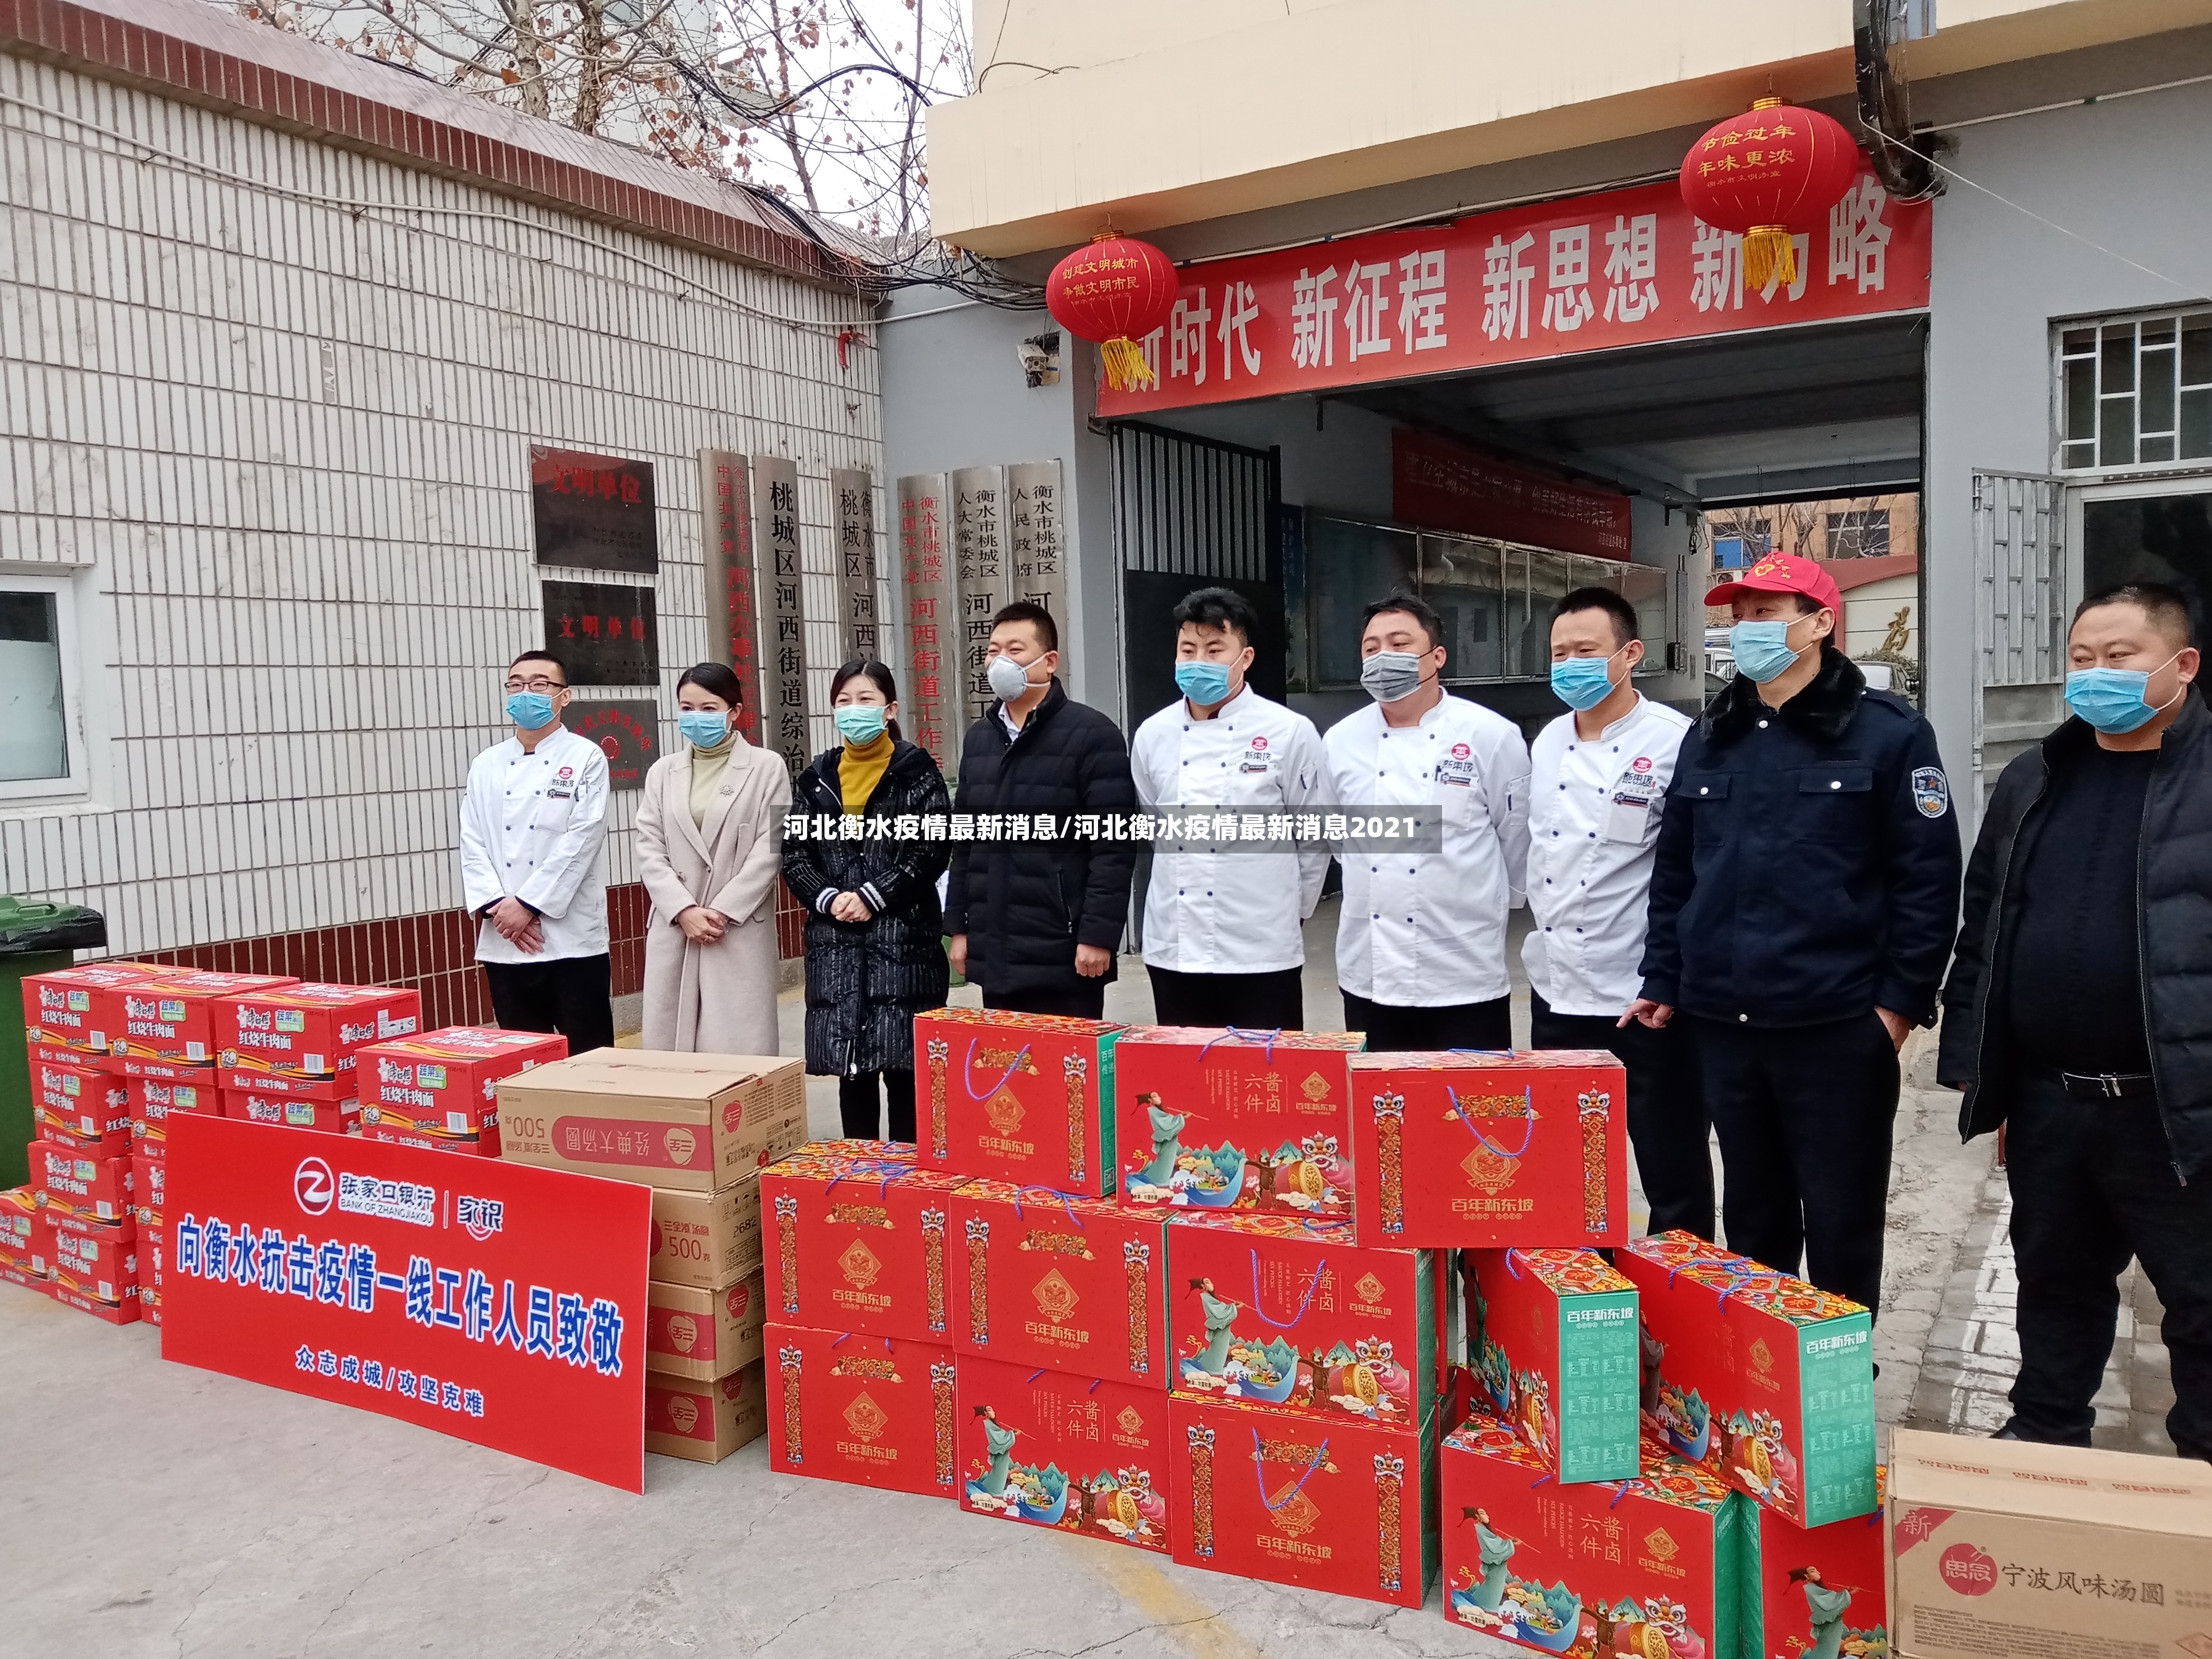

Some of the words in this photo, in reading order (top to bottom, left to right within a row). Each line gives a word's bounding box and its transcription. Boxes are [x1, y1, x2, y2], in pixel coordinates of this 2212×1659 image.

[1702, 124, 1796, 152] 节俭过年
[1698, 148, 1795, 178] 年味更浓
[1062, 257, 1138, 280] 创建文明城市
[1063, 276, 1139, 299] 争做文明市民
[1291, 248, 1448, 368] 新征程
[1481, 213, 1660, 342] 新思想
[548, 464, 642, 503] 文明单位
[717, 464, 734, 554] 中国共产党
[840, 488, 861, 579] 桃城区
[860, 490, 875, 580] 衡水市
[902, 499, 920, 584] 中国共产党
[919, 497, 943, 583] 衡水市桃城区
[958, 491, 977, 580] 人大常委会
[975, 489, 1000, 578] 衡水市桃城区
[1012, 488, 1033, 579] 人民政府
[1032, 484, 1057, 575] 衡水市桃城区
[558, 614, 646, 640] 文明单位
[852, 591, 876, 660] 河西
[41, 1009, 81, 1028] 红烧牛肉面
[128, 1020, 175, 1039] 红烧牛肉面
[238, 1030, 292, 1051] 红烧牛肉面
[380, 1085, 434, 1108] 红烧牛肉面
[1244, 1073, 1264, 1114] 六件
[1262, 1071, 1283, 1115] 酱卤
[725, 1107, 740, 1125] 三全
[566, 1126, 650, 1157] 经典大汤圆
[669, 1138, 692, 1153] 三全
[978, 1135, 1034, 1155] 百年新东坡
[341, 1175, 434, 1210] 张家口银行
[1452, 1199, 1534, 1212] 百年新东坡
[340, 1198, 363, 1211] BANK
[364, 1202, 376, 1213] OF
[378, 1204, 432, 1224] ZHANGJIAKOU
[459, 1197, 503, 1230] 家银
[177, 1214, 623, 1376] 向衡水抗击疫情一线工作人员致敬
[730, 1293, 747, 1311] 三全
[832, 1289, 892, 1307] 百年新东坡
[1348, 1303, 1393, 1316] 百年新东坡
[1566, 1307, 1634, 1323] 百年新东坡
[672, 1325, 694, 1342] 三全
[1025, 1321, 1089, 1343] 百年新东坡
[1806, 1330, 1867, 1354] 百年新东坡
[295, 1345, 484, 1418] 众志成城/攻坚克难
[673, 1406, 695, 1422] 三全
[1066, 1399, 1085, 1439] 六件
[1082, 1400, 1101, 1443] 酱卤
[836, 1441, 898, 1460] 百年新东坡
[1112, 1432, 1150, 1447] 百年新东坡
[1579, 1513, 1603, 1559] 六件
[1601, 1515, 1624, 1565] 酱卤
[1903, 1509, 1932, 1543] 新
[1256, 1534, 1332, 1560] 百年新东坡
[1638, 1557, 1686, 1578] 百年新东坡
[1945, 1559, 1993, 1582] 思念
[2001, 1563, 2165, 1606] 宁波风味汤圆
